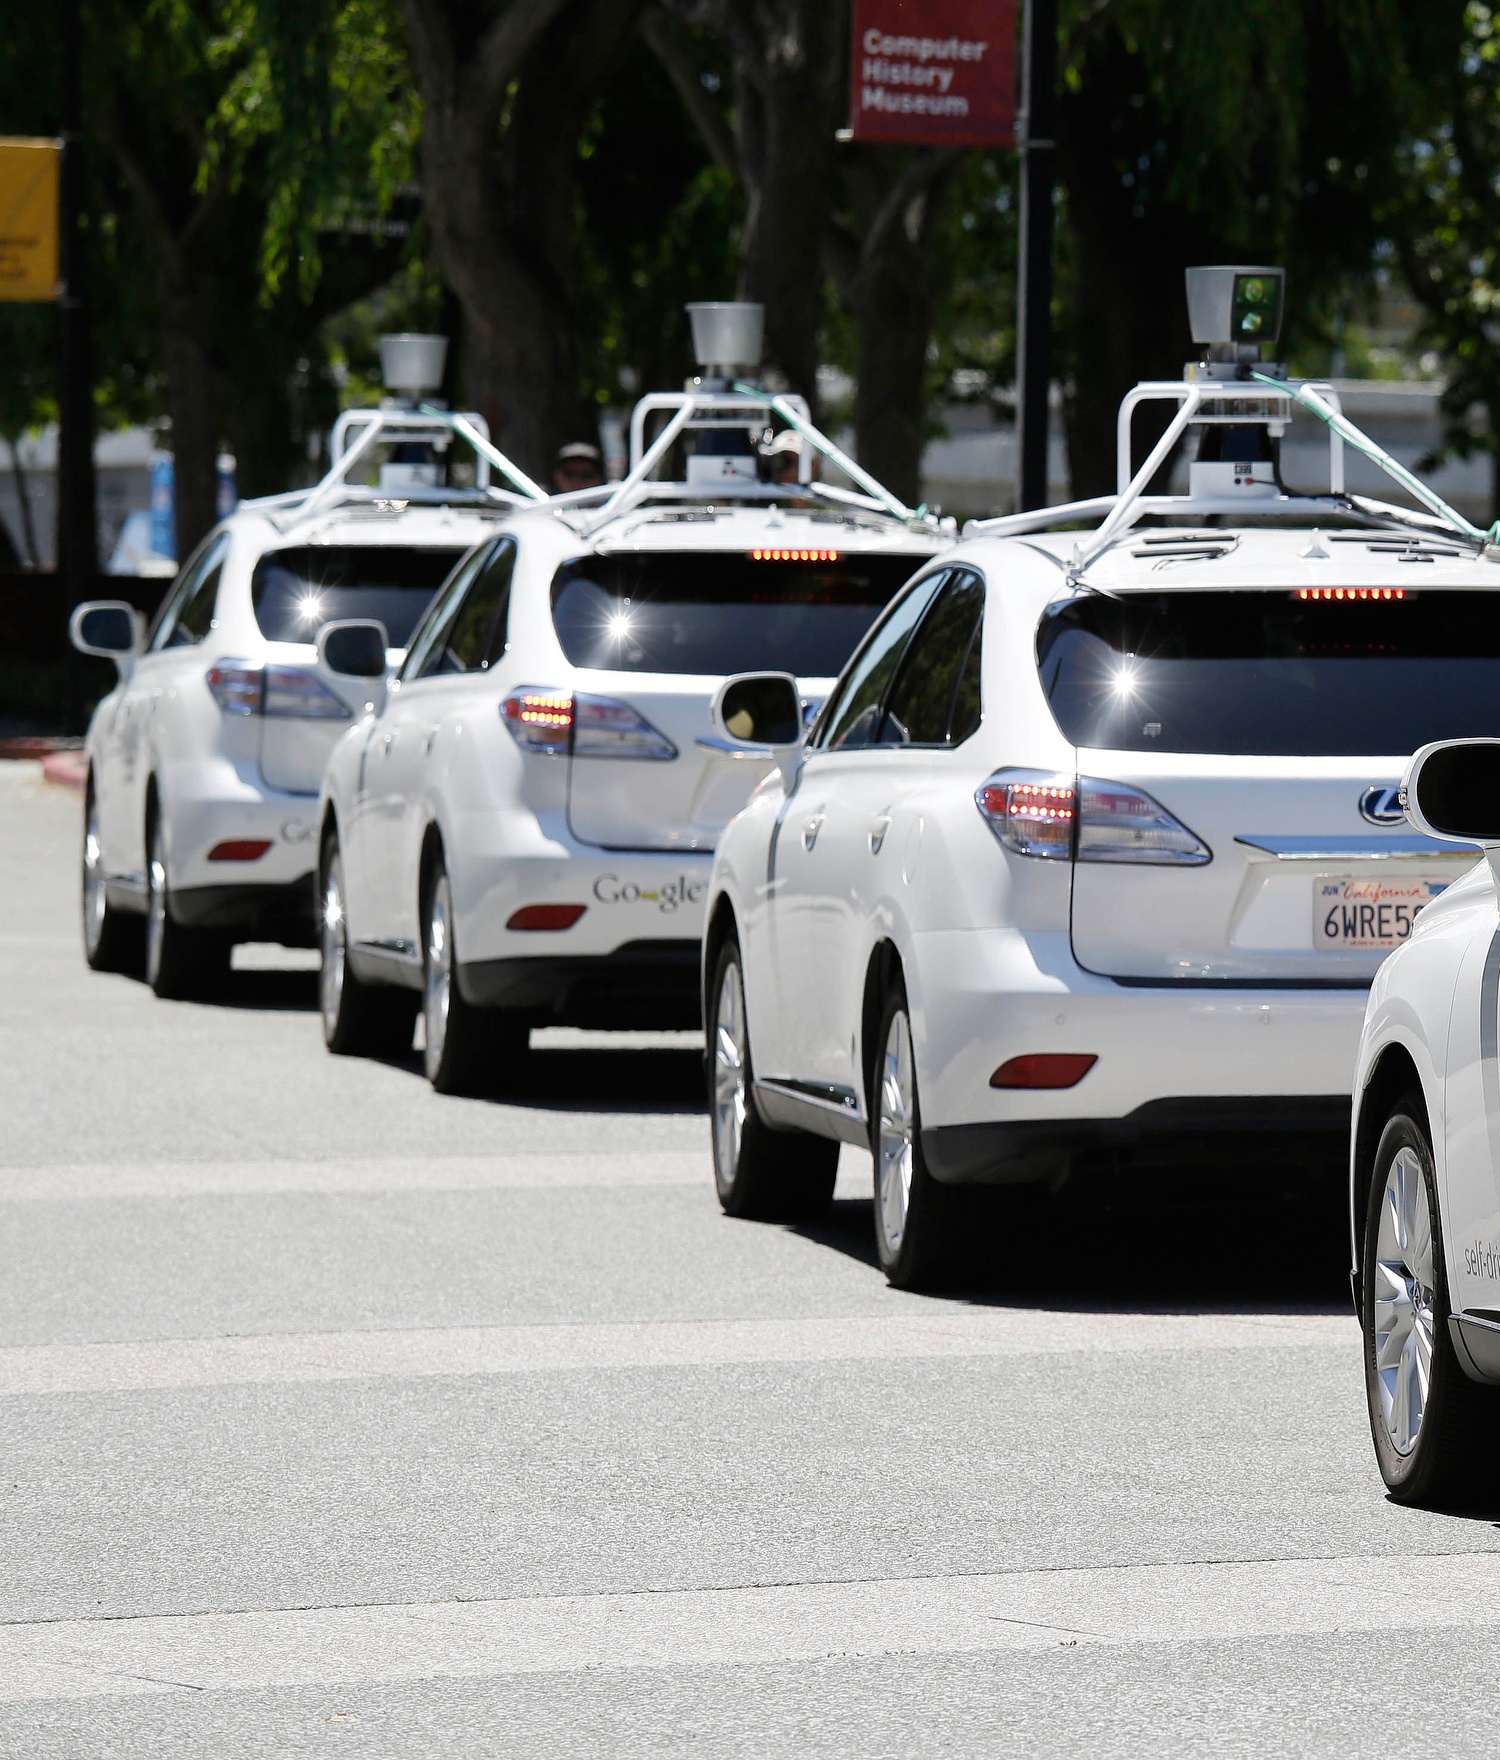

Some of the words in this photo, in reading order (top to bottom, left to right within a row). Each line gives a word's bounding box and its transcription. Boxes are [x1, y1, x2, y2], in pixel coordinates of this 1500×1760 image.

[863, 28, 988, 63] Computer
[862, 58, 955, 93] History
[862, 86, 970, 117] Museum
[1322, 885, 1339, 896] JUN
[1343, 881, 1428, 904] California
[1324, 904, 1424, 939] 6WRE5
